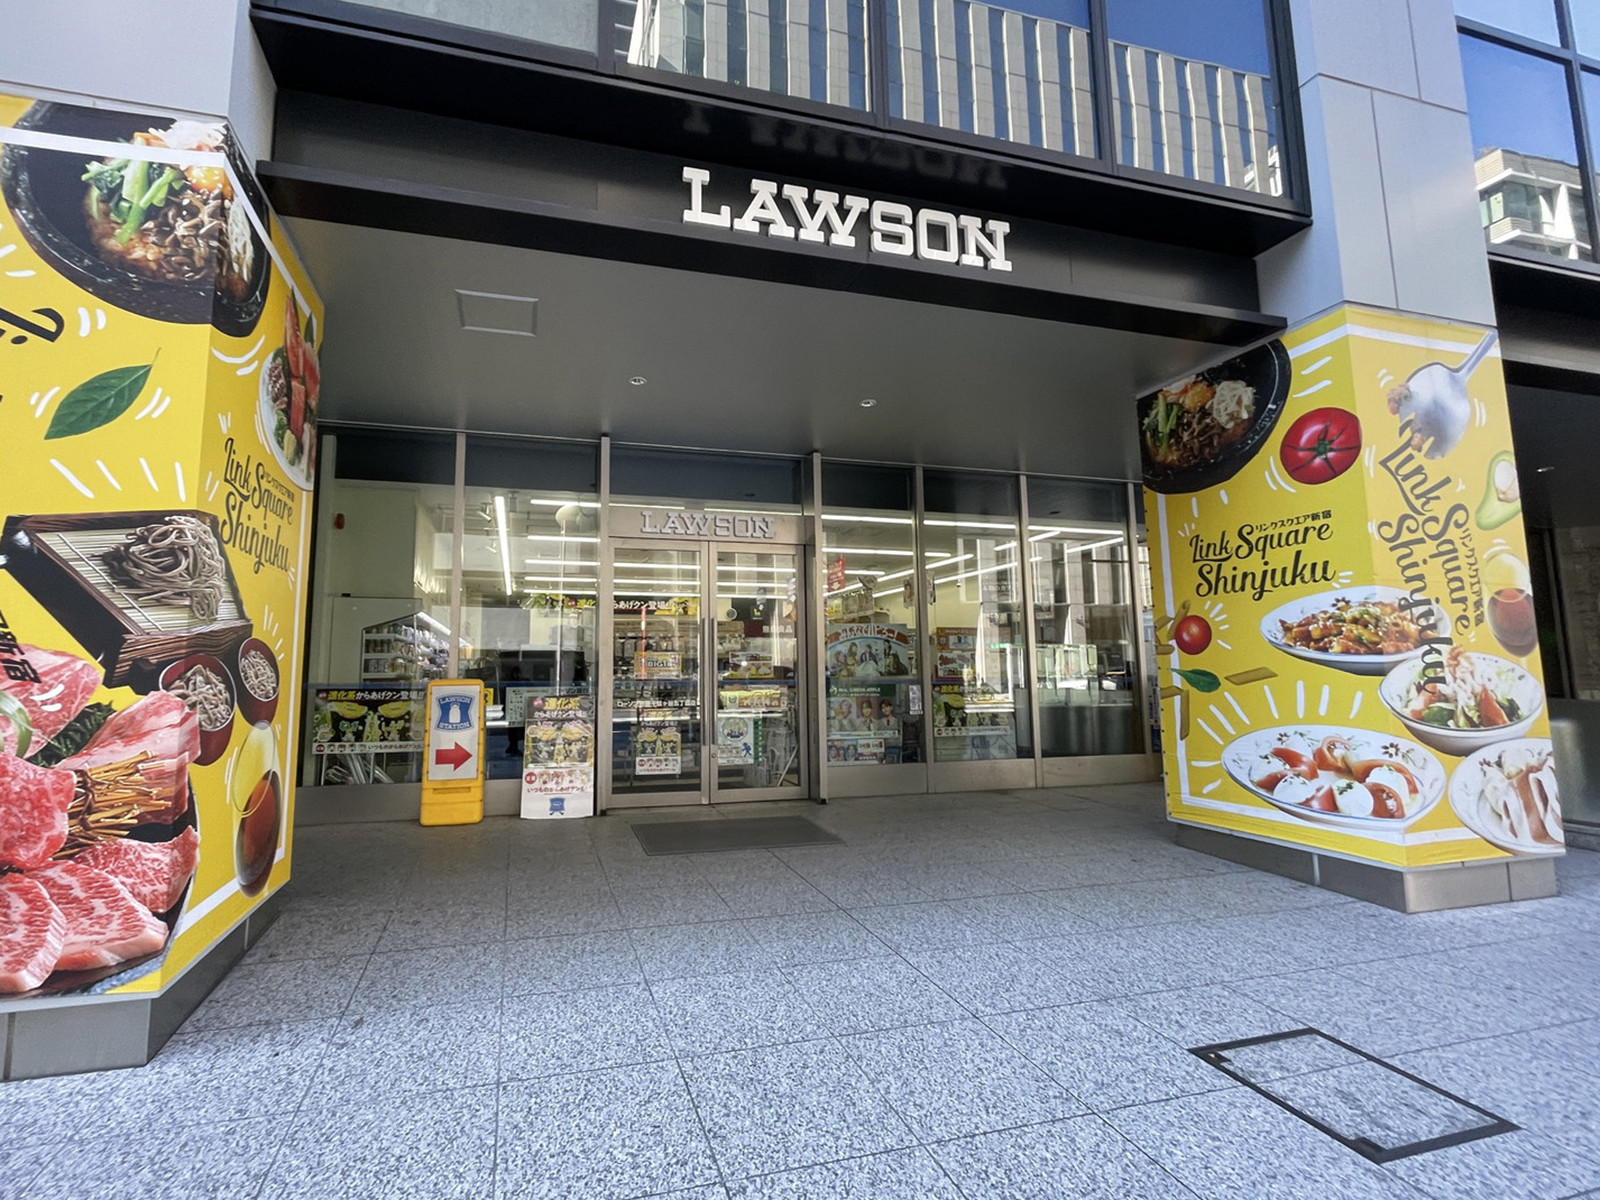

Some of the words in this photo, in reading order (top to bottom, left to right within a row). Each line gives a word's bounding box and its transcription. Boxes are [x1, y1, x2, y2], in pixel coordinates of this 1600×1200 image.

[682, 166, 1013, 272] LAWSON
[224, 437, 252, 502] Link
[251, 462, 294, 525] Square
[220, 491, 289, 575] Shinjuku
[641, 511, 774, 539] LAWSON
[1189, 530, 1234, 563] Link
[1235, 524, 1334, 560] Square
[1255, 510, 1332, 533] リンクスクエア新宿
[1378, 418, 1453, 517] Link
[1421, 502, 1473, 636] Square
[1196, 550, 1337, 601] Shinjuku
[1377, 513, 1454, 694] Shinjuku
[439, 722, 470, 730] STATION
